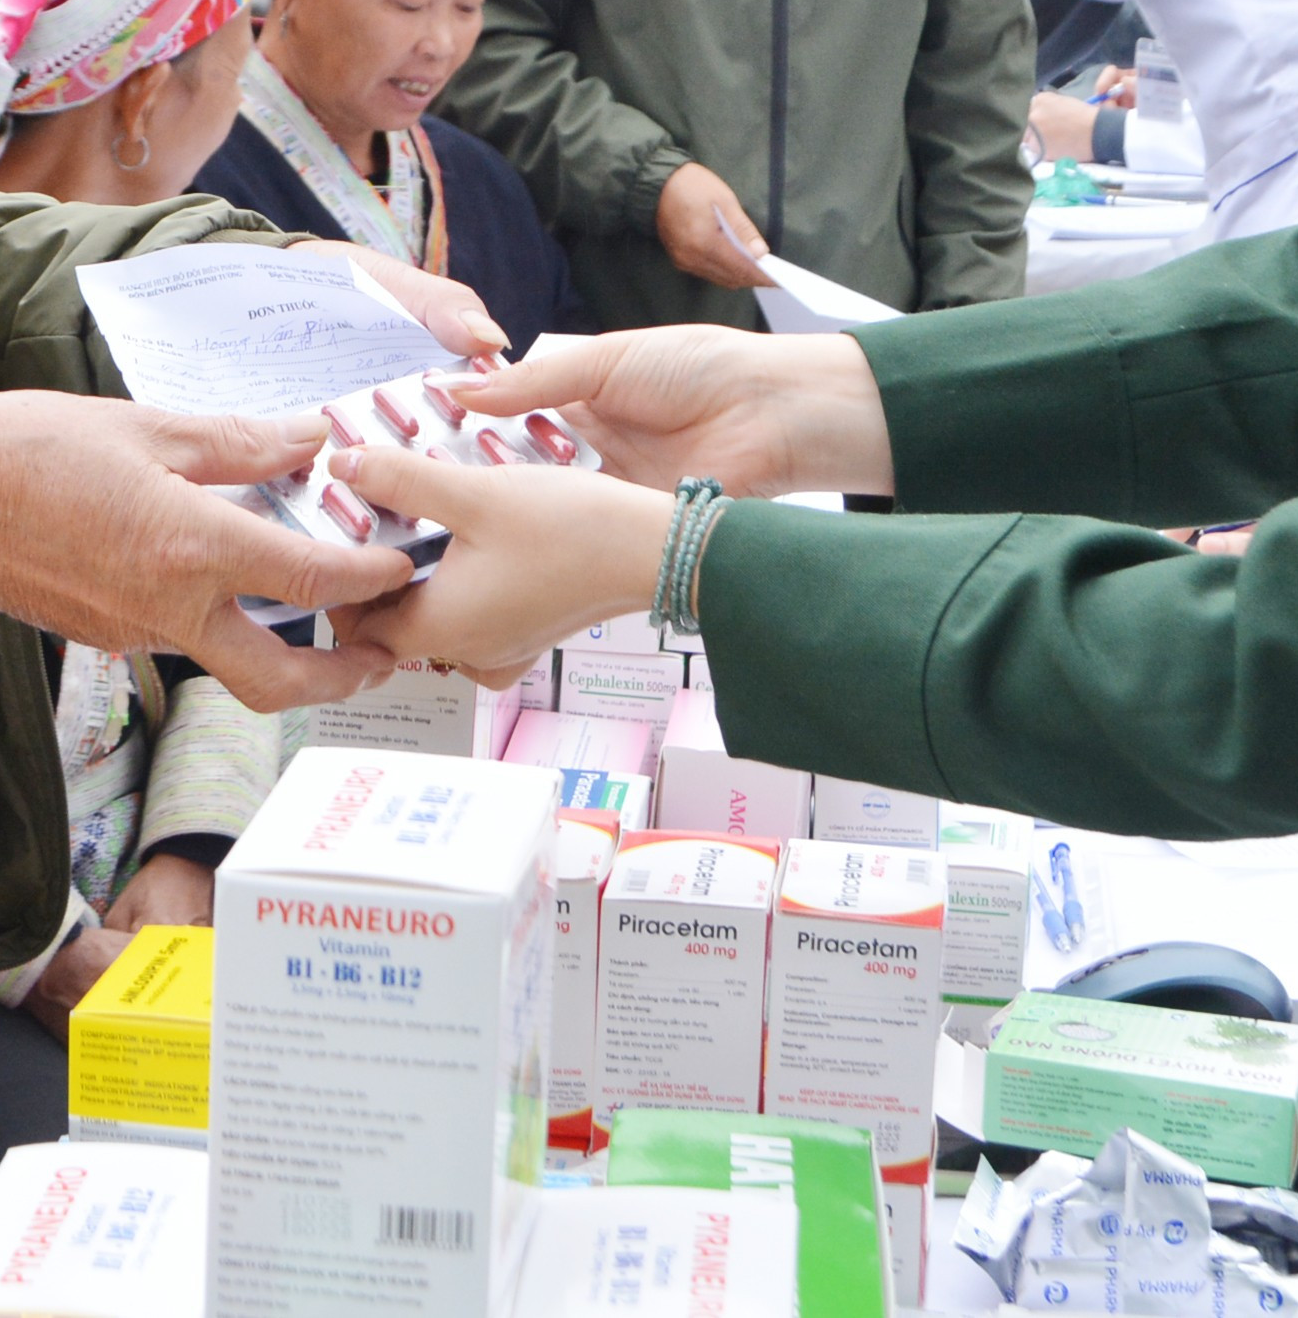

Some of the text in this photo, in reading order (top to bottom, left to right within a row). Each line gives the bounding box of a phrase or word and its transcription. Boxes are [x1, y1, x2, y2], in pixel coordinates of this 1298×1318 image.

[248, 298, 320, 320] ĐƠN THUỐC
[397, 660, 422, 672] 400
[568, 670, 644, 692] Cephalexin
[646, 683, 677, 696] 500mg
[303, 765, 385, 852] PYRANEURO
[948, 891, 1022, 911] alexin 500mg
[256, 896, 456, 939] PYRANEURO
[618, 913, 738, 941] Piracetam
[319, 937, 391, 958] Vitamin
[684, 942, 737, 960] 400 mg
[797, 931, 917, 961] Piracetam
[286, 957, 422, 988] B1 B6 B12
[864, 962, 916, 979] 400 mg
[1143, 1170, 1201, 1187] PHARMA
[0, 1166, 89, 1285] PYRANEURO
[688, 1211, 732, 1318] PYRANEUR
[1138, 1279, 1198, 1295] PHARMA
